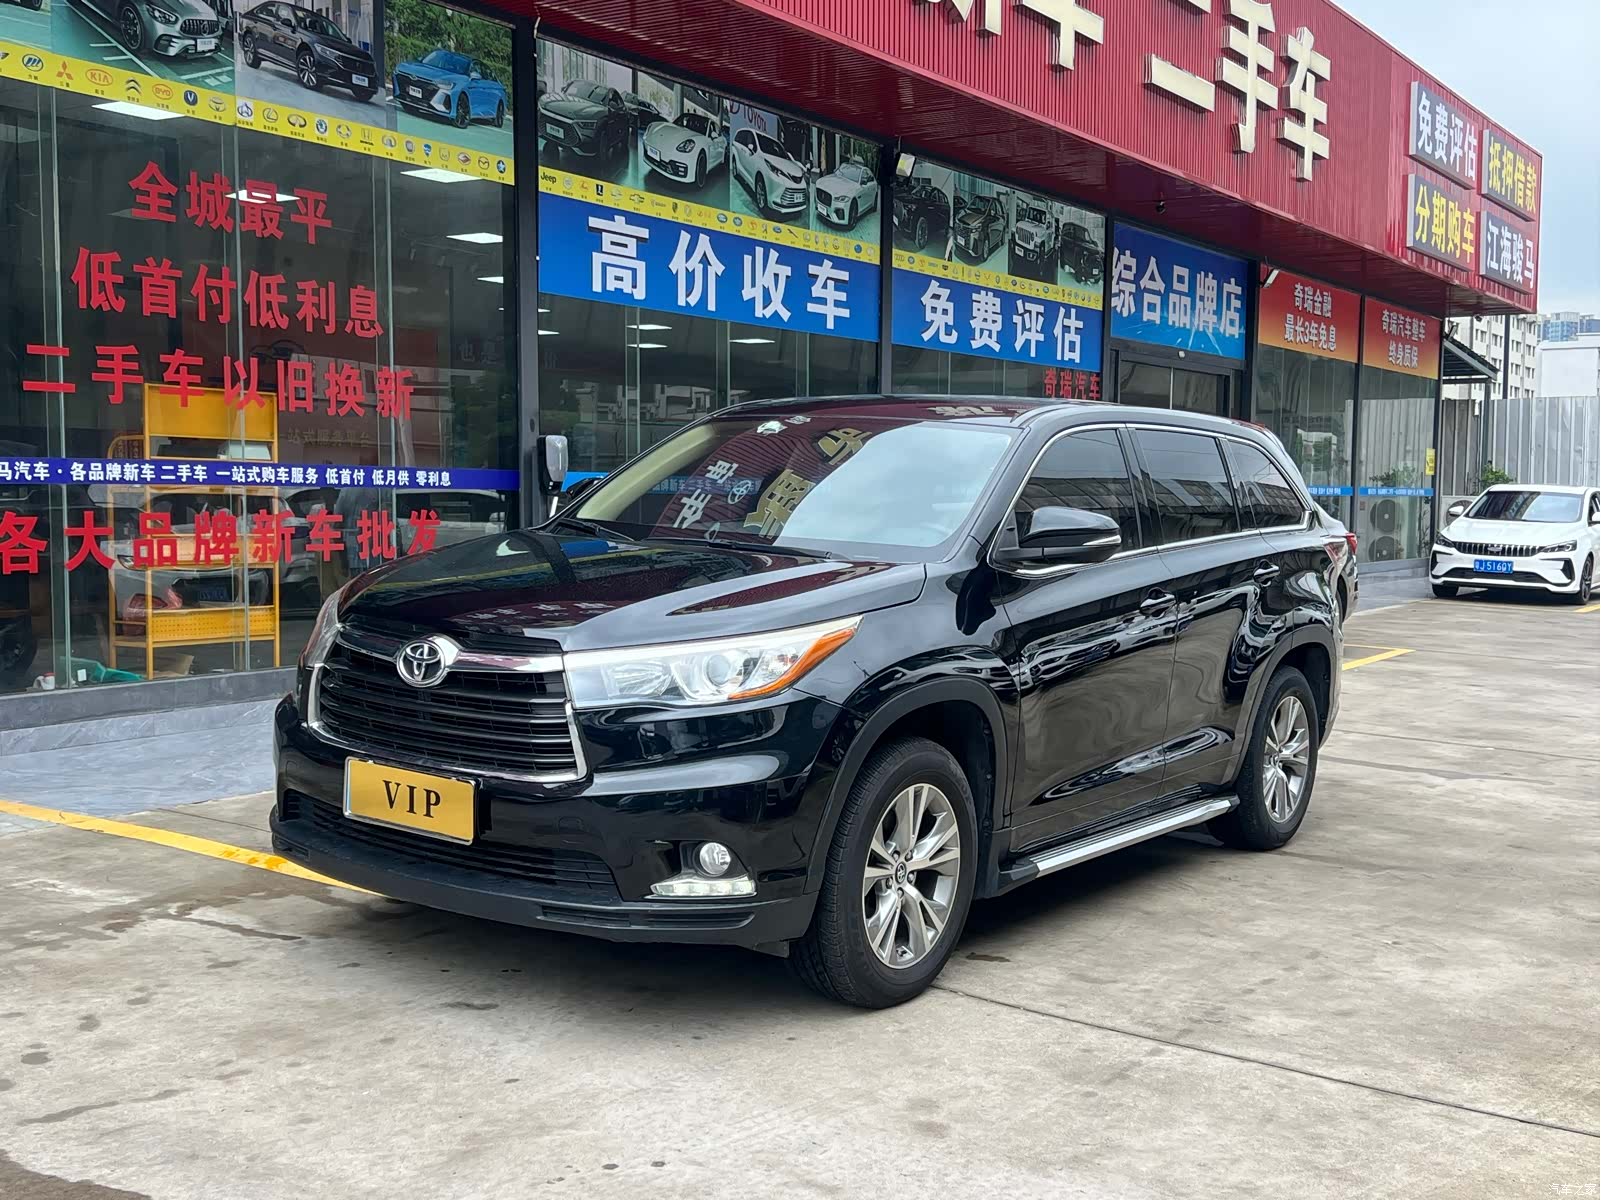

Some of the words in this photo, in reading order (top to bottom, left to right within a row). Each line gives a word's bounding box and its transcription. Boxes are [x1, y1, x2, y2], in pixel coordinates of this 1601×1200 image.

[90, 71, 109, 84] KIA
[1418, 91, 1477, 181] 免费评估
[128, 161, 333, 244] 全城最平
[540, 172, 557, 184] Jeep
[1489, 137, 1537, 214] 抵押借款
[1415, 183, 1475, 264] 分期购车
[1487, 219, 1535, 289] 江海骏马
[70, 246, 384, 339] 低首付低利息
[587, 214, 851, 330] 高价收车
[1111, 246, 1243, 339] 综合品牌店
[1294, 282, 1332, 319] 奇瑞金融
[920, 279, 1084, 364] 免费评估
[1284, 313, 1337, 352] 最长3年免息
[1381, 308, 1426, 343] 奇瑞汽车整车
[1388, 340, 1418, 368] 终身质保
[22, 343, 415, 420] 二手车以旧换新
[1044, 367, 1100, 400] 奇瑞汽车
[161, 464, 208, 483] 二手车
[216, 465, 319, 485] 一站式购车服务
[325, 467, 365, 485] 低首付
[372, 468, 410, 486] 低月供
[415, 470, 452, 487] 零利息
[0, 509, 442, 575] 各大品牌新车批发
[382, 779, 442, 819] VIP
